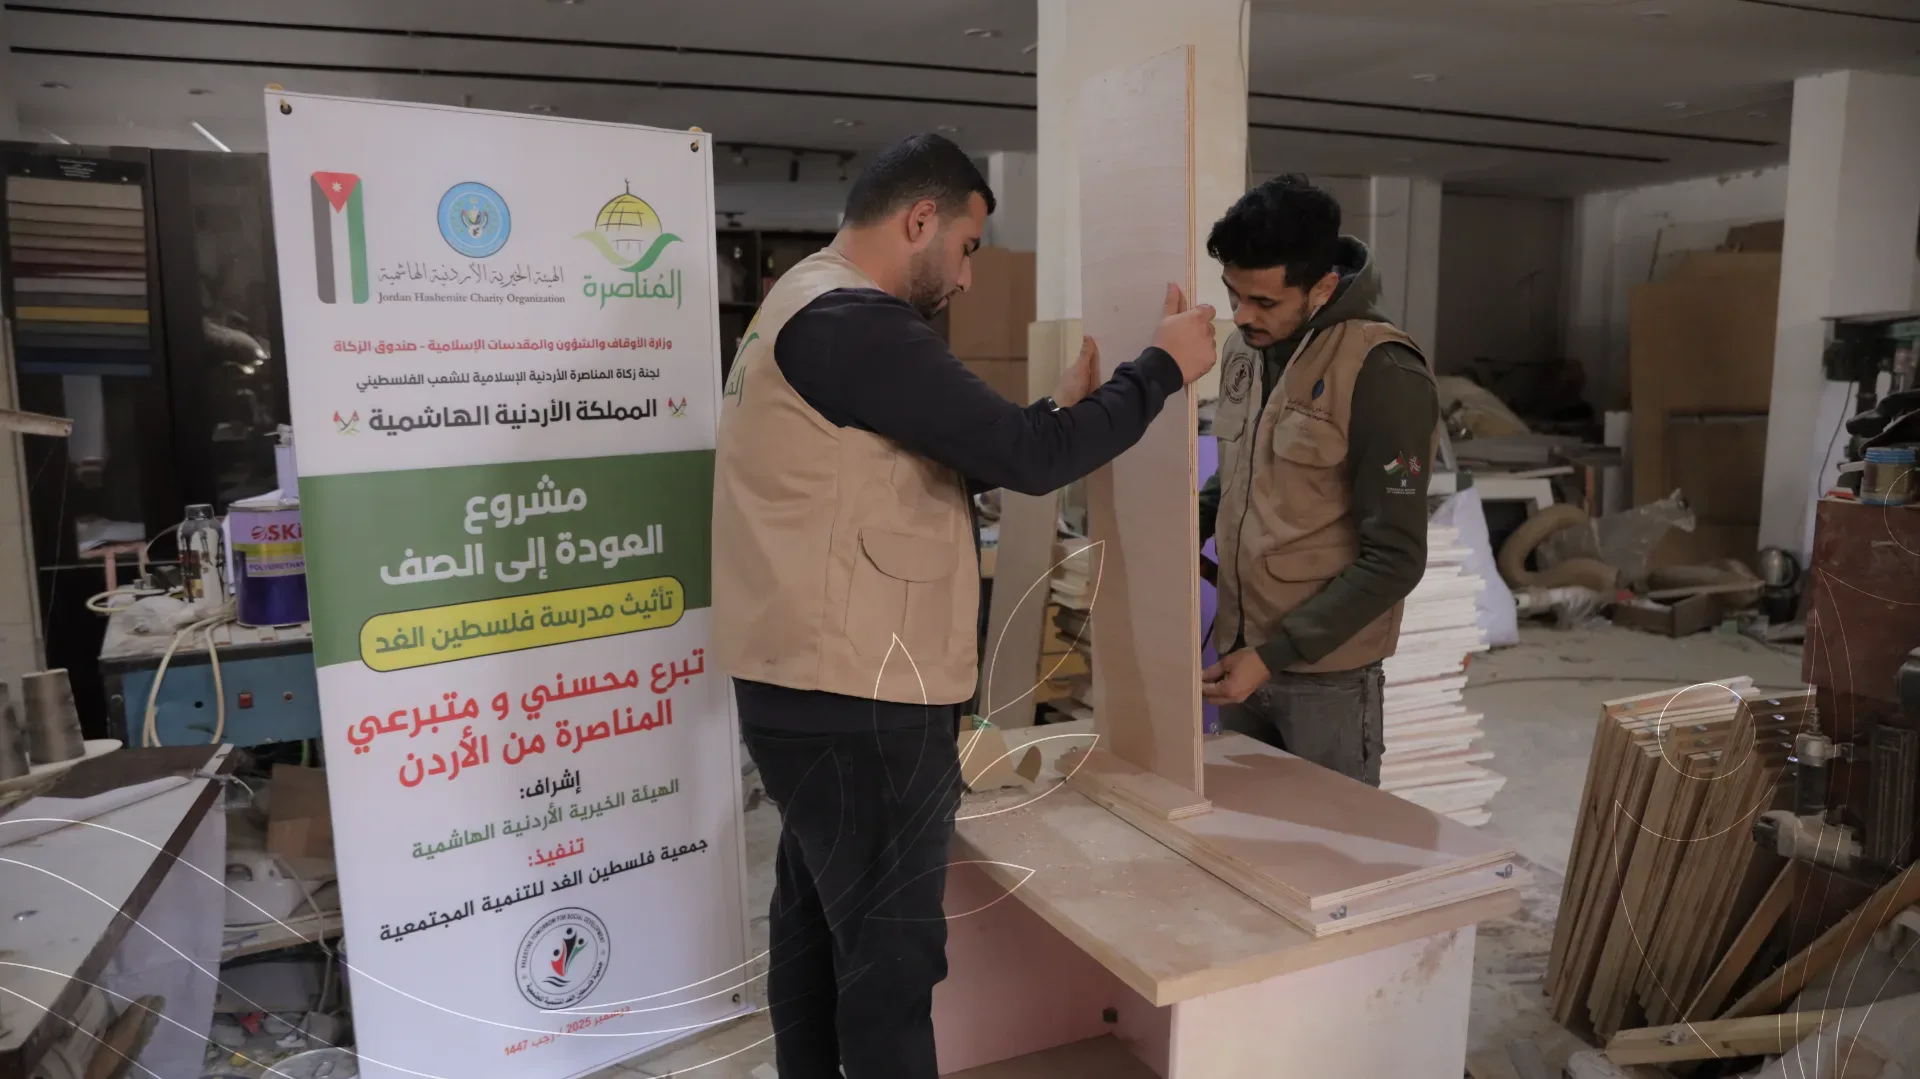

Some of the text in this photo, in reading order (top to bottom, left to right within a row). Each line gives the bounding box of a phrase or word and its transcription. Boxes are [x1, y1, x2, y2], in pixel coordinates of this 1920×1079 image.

[377, 261, 564, 288] الهيئة الخيرية الأردنية الهاشمية
[378, 292, 565, 305] Jordan Hashemite Charity Organization
[333, 340, 371, 354] الزكاة
[374, 340, 417, 354] صندوق
[428, 339, 485, 353] الإسلامية
[488, 338, 553, 351] والمقدسات
[556, 338, 606, 351] والشؤون
[607, 336, 647, 350] الأوقاف
[649, 338, 672, 350] وزارة
[356, 368, 660, 393] لجنة زكاة المناصرة الأردنية الإسلامية للشعب الفلسطيني
[368, 398, 657, 436] المملكة الأردنية الهاشمية
[463, 474, 588, 535] مشروع
[268, 523, 303, 541] SKi
[249, 560, 305, 571] POLYURETHAN
[380, 524, 663, 586] العودة إلى الصف
[376, 584, 673, 654] تأثيث مدرسة فلسطين الغد
[346, 648, 705, 755] تبرع محسني و متبرعي
[399, 698, 672, 788] المناصرة من الأردن
[519, 769, 581, 800] إشراف:
[411, 778, 680, 860] الهيئة الخيرية الأردنية الهاشمية
[528, 837, 585, 868] تنفيذ:
[379, 837, 708, 944] جمعية فلسطين الغد للتنمية المجتمعية
[521, 913, 606, 968] PALESTINE TOMORROW FOR SOCIAL DEVELOPMENT
[566, 1016, 592, 1034] 2025
[504, 1039, 528, 1057] 1447
